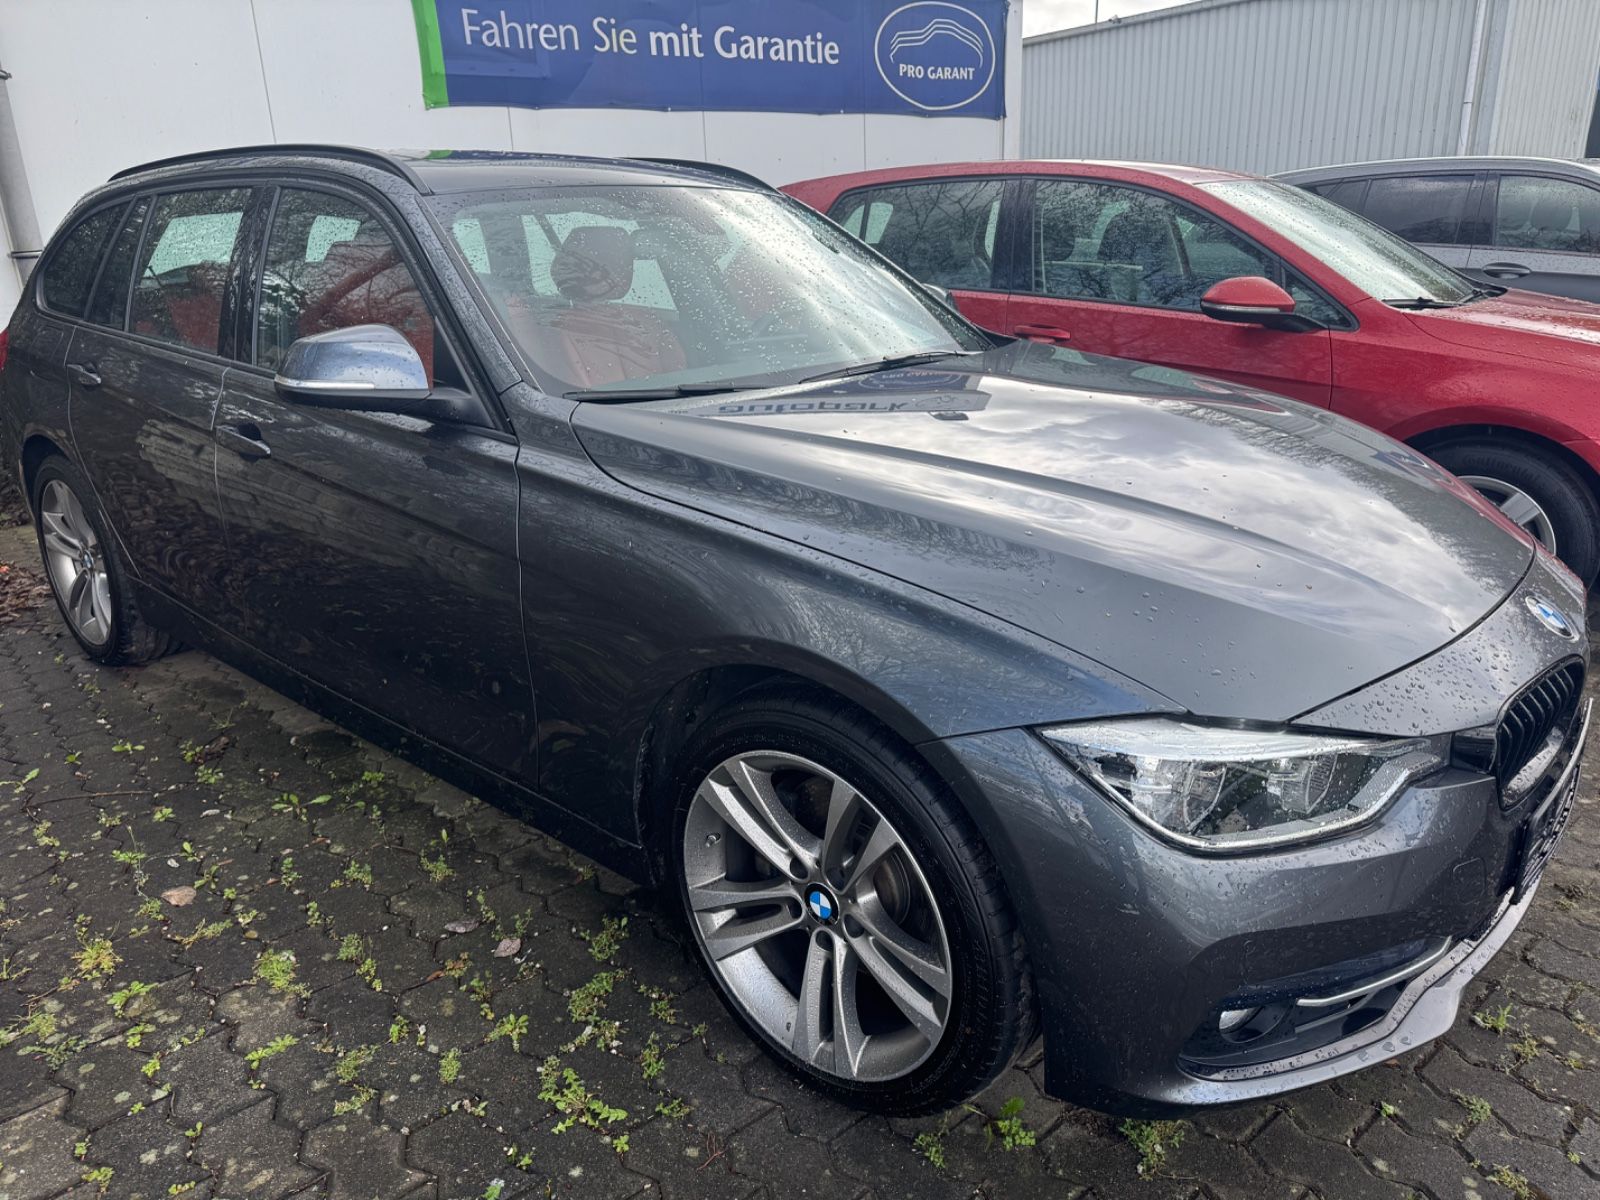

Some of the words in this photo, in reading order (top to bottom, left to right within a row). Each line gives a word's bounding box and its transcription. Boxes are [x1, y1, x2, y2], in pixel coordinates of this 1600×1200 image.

[461, 8, 579, 51] Fahren
[592, 16, 638, 55] Sie
[649, 23, 704, 58] mit
[714, 25, 840, 65] Garantie
[899, 63, 924, 79] PRO
[927, 66, 976, 81] GARANT
